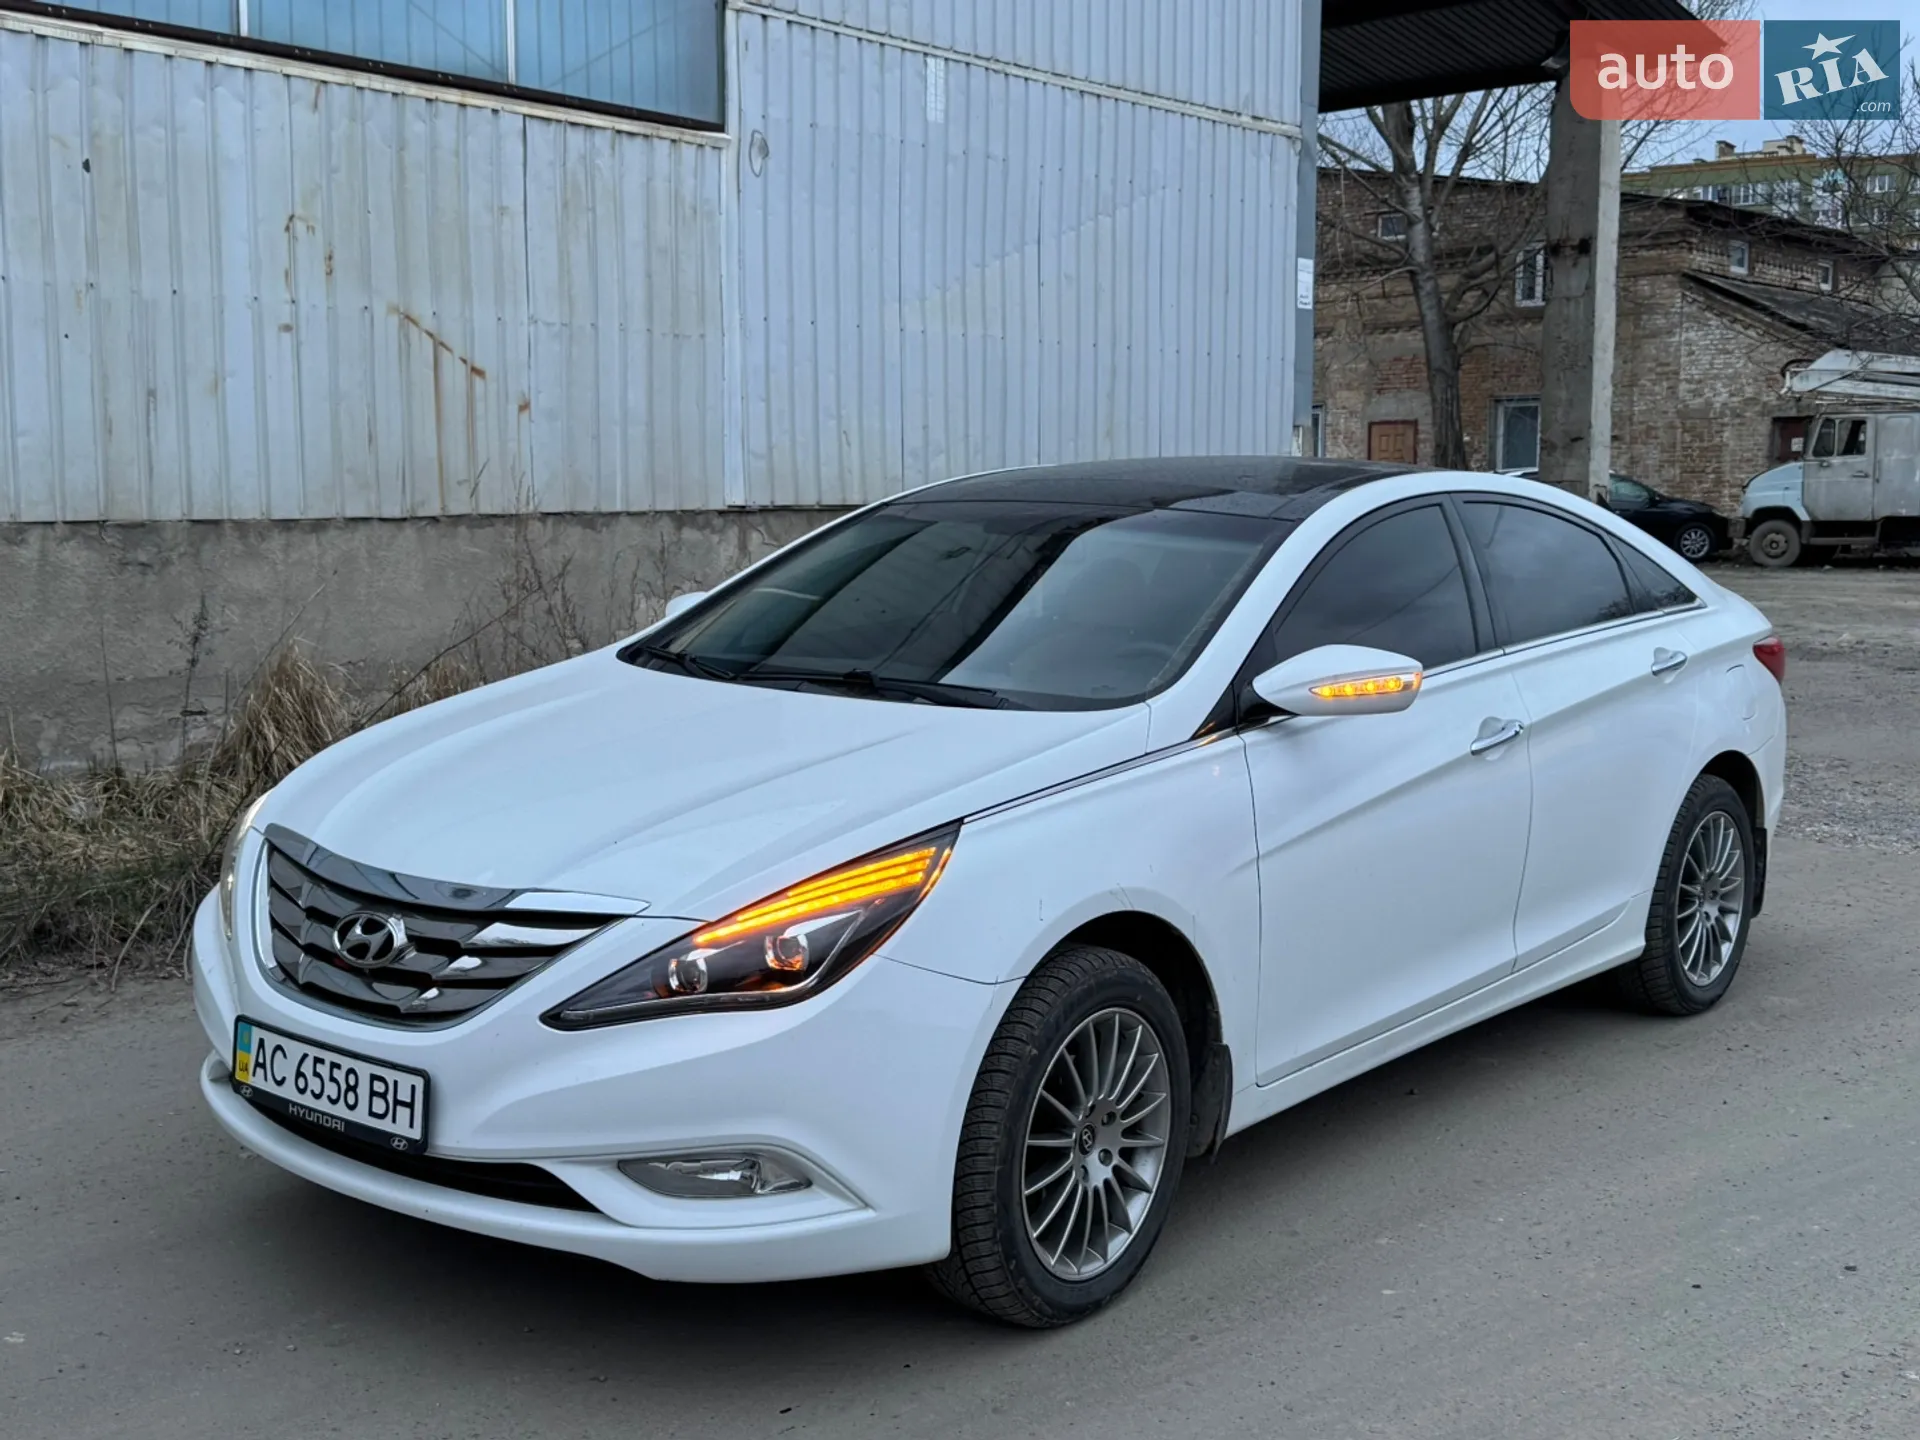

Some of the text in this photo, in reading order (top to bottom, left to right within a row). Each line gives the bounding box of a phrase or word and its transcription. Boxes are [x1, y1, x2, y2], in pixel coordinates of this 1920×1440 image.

[252, 1037, 416, 1129] AC 6558 BH
[288, 1103, 345, 1132] HYUNDAI
